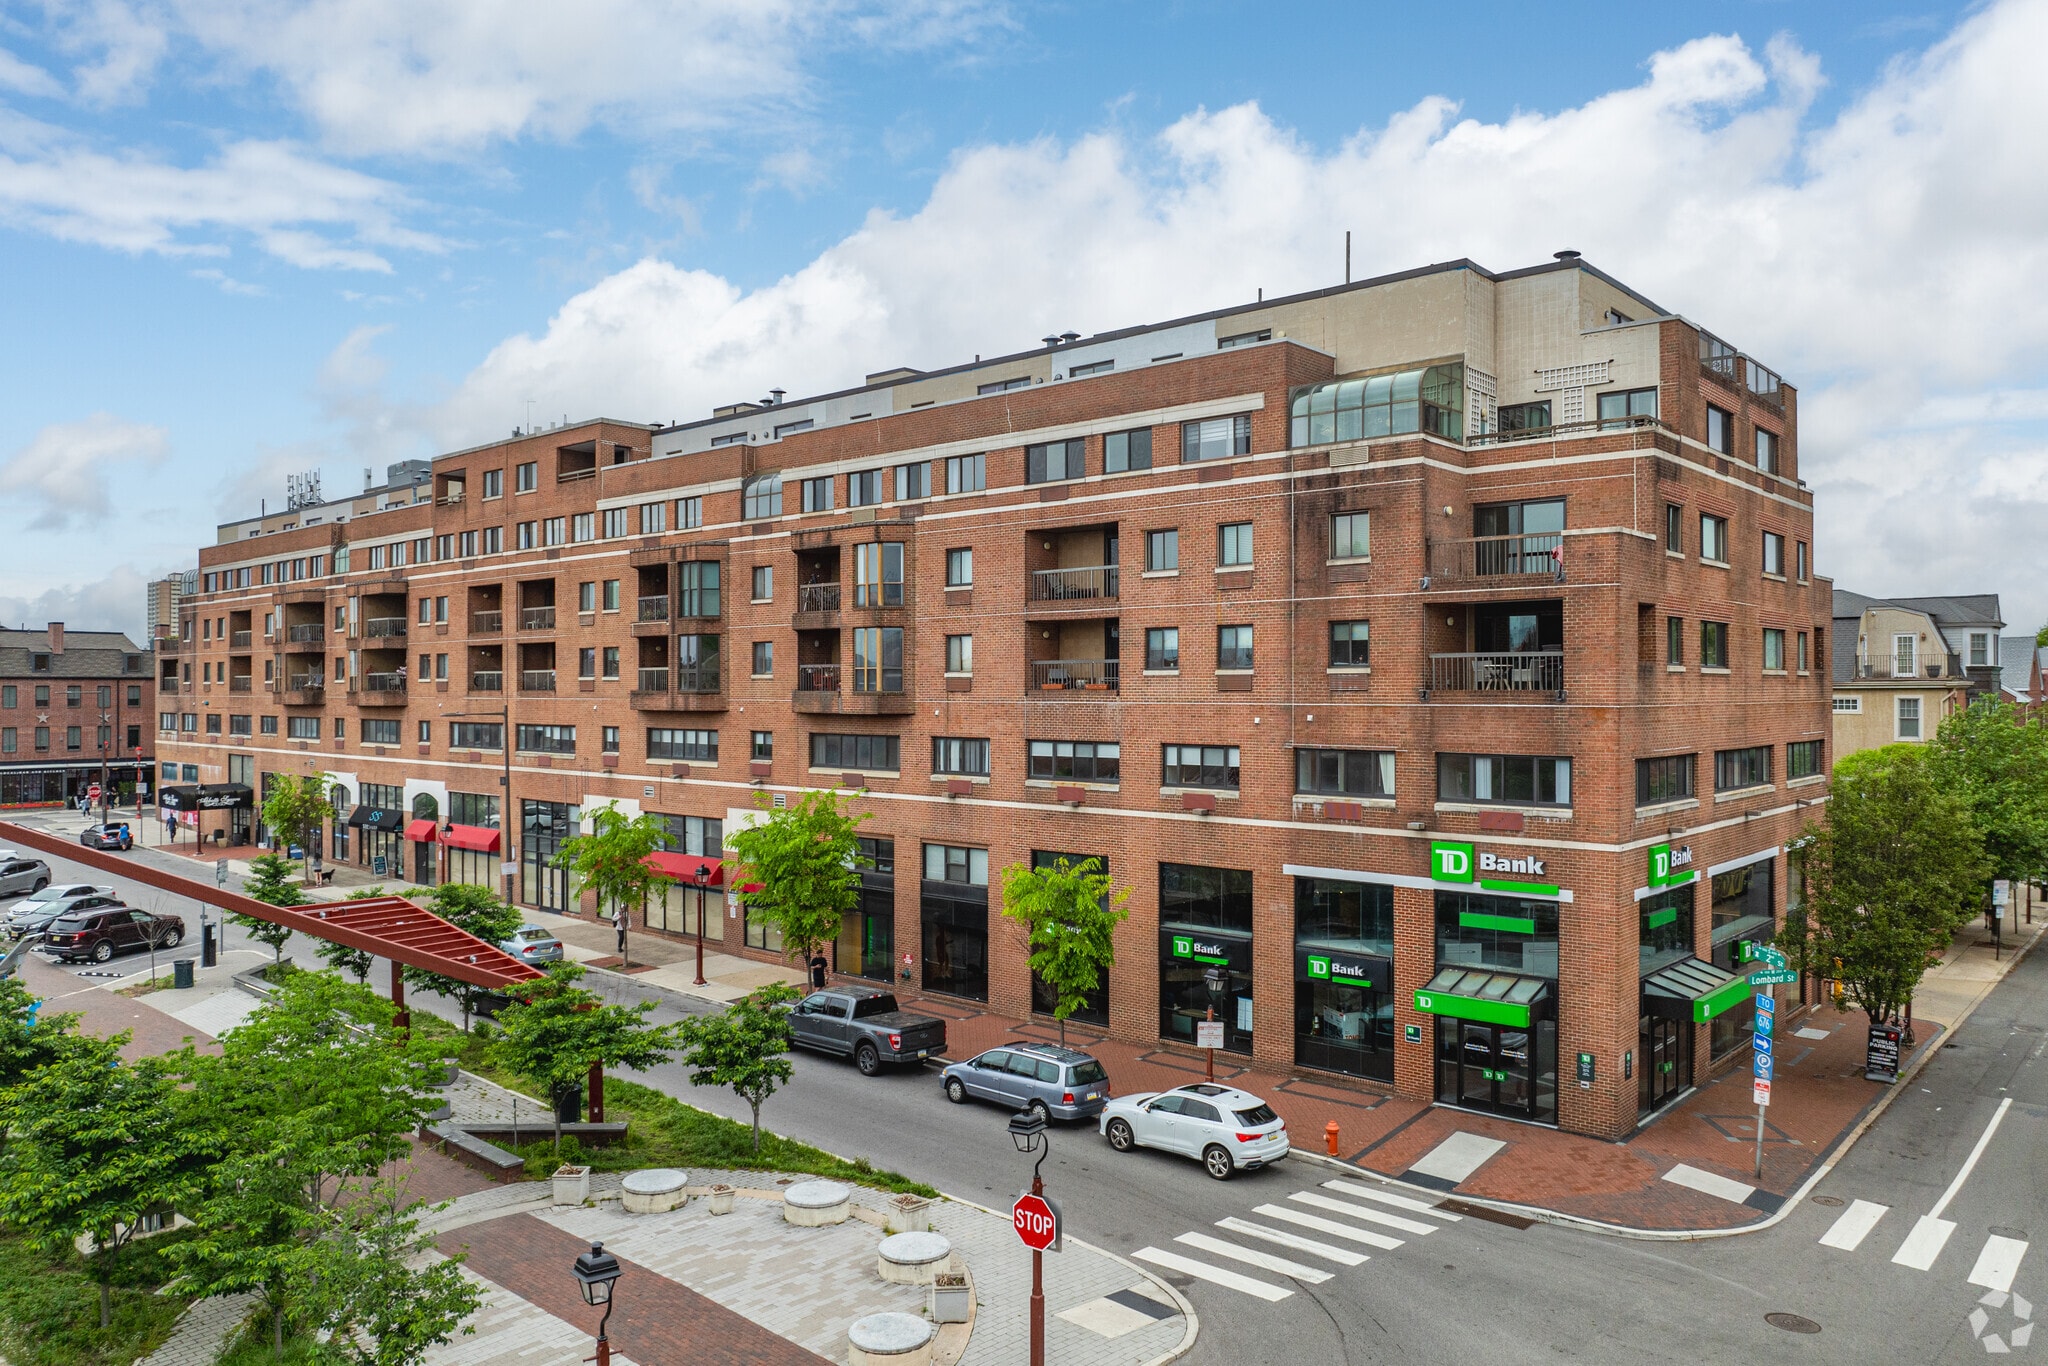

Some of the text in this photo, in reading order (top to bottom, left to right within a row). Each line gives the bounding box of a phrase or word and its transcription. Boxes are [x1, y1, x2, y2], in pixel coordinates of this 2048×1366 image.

[1435, 849, 1545, 875] TD Bank
[1655, 845, 1692, 878] TD Bank
[1175, 940, 1222, 955] TD Bank
[1310, 960, 1364, 976] TD Bank
[1751, 974, 1794, 985] Lombard St
[1417, 996, 1432, 1008] TD
[1761, 997, 1770, 1008] TO
[1758, 1016, 1770, 1030] 676
[1870, 1042, 1898, 1051] PARKING
[1872, 1038, 1896, 1046] PUBLIC
[1015, 1208, 1053, 1236] STOP
